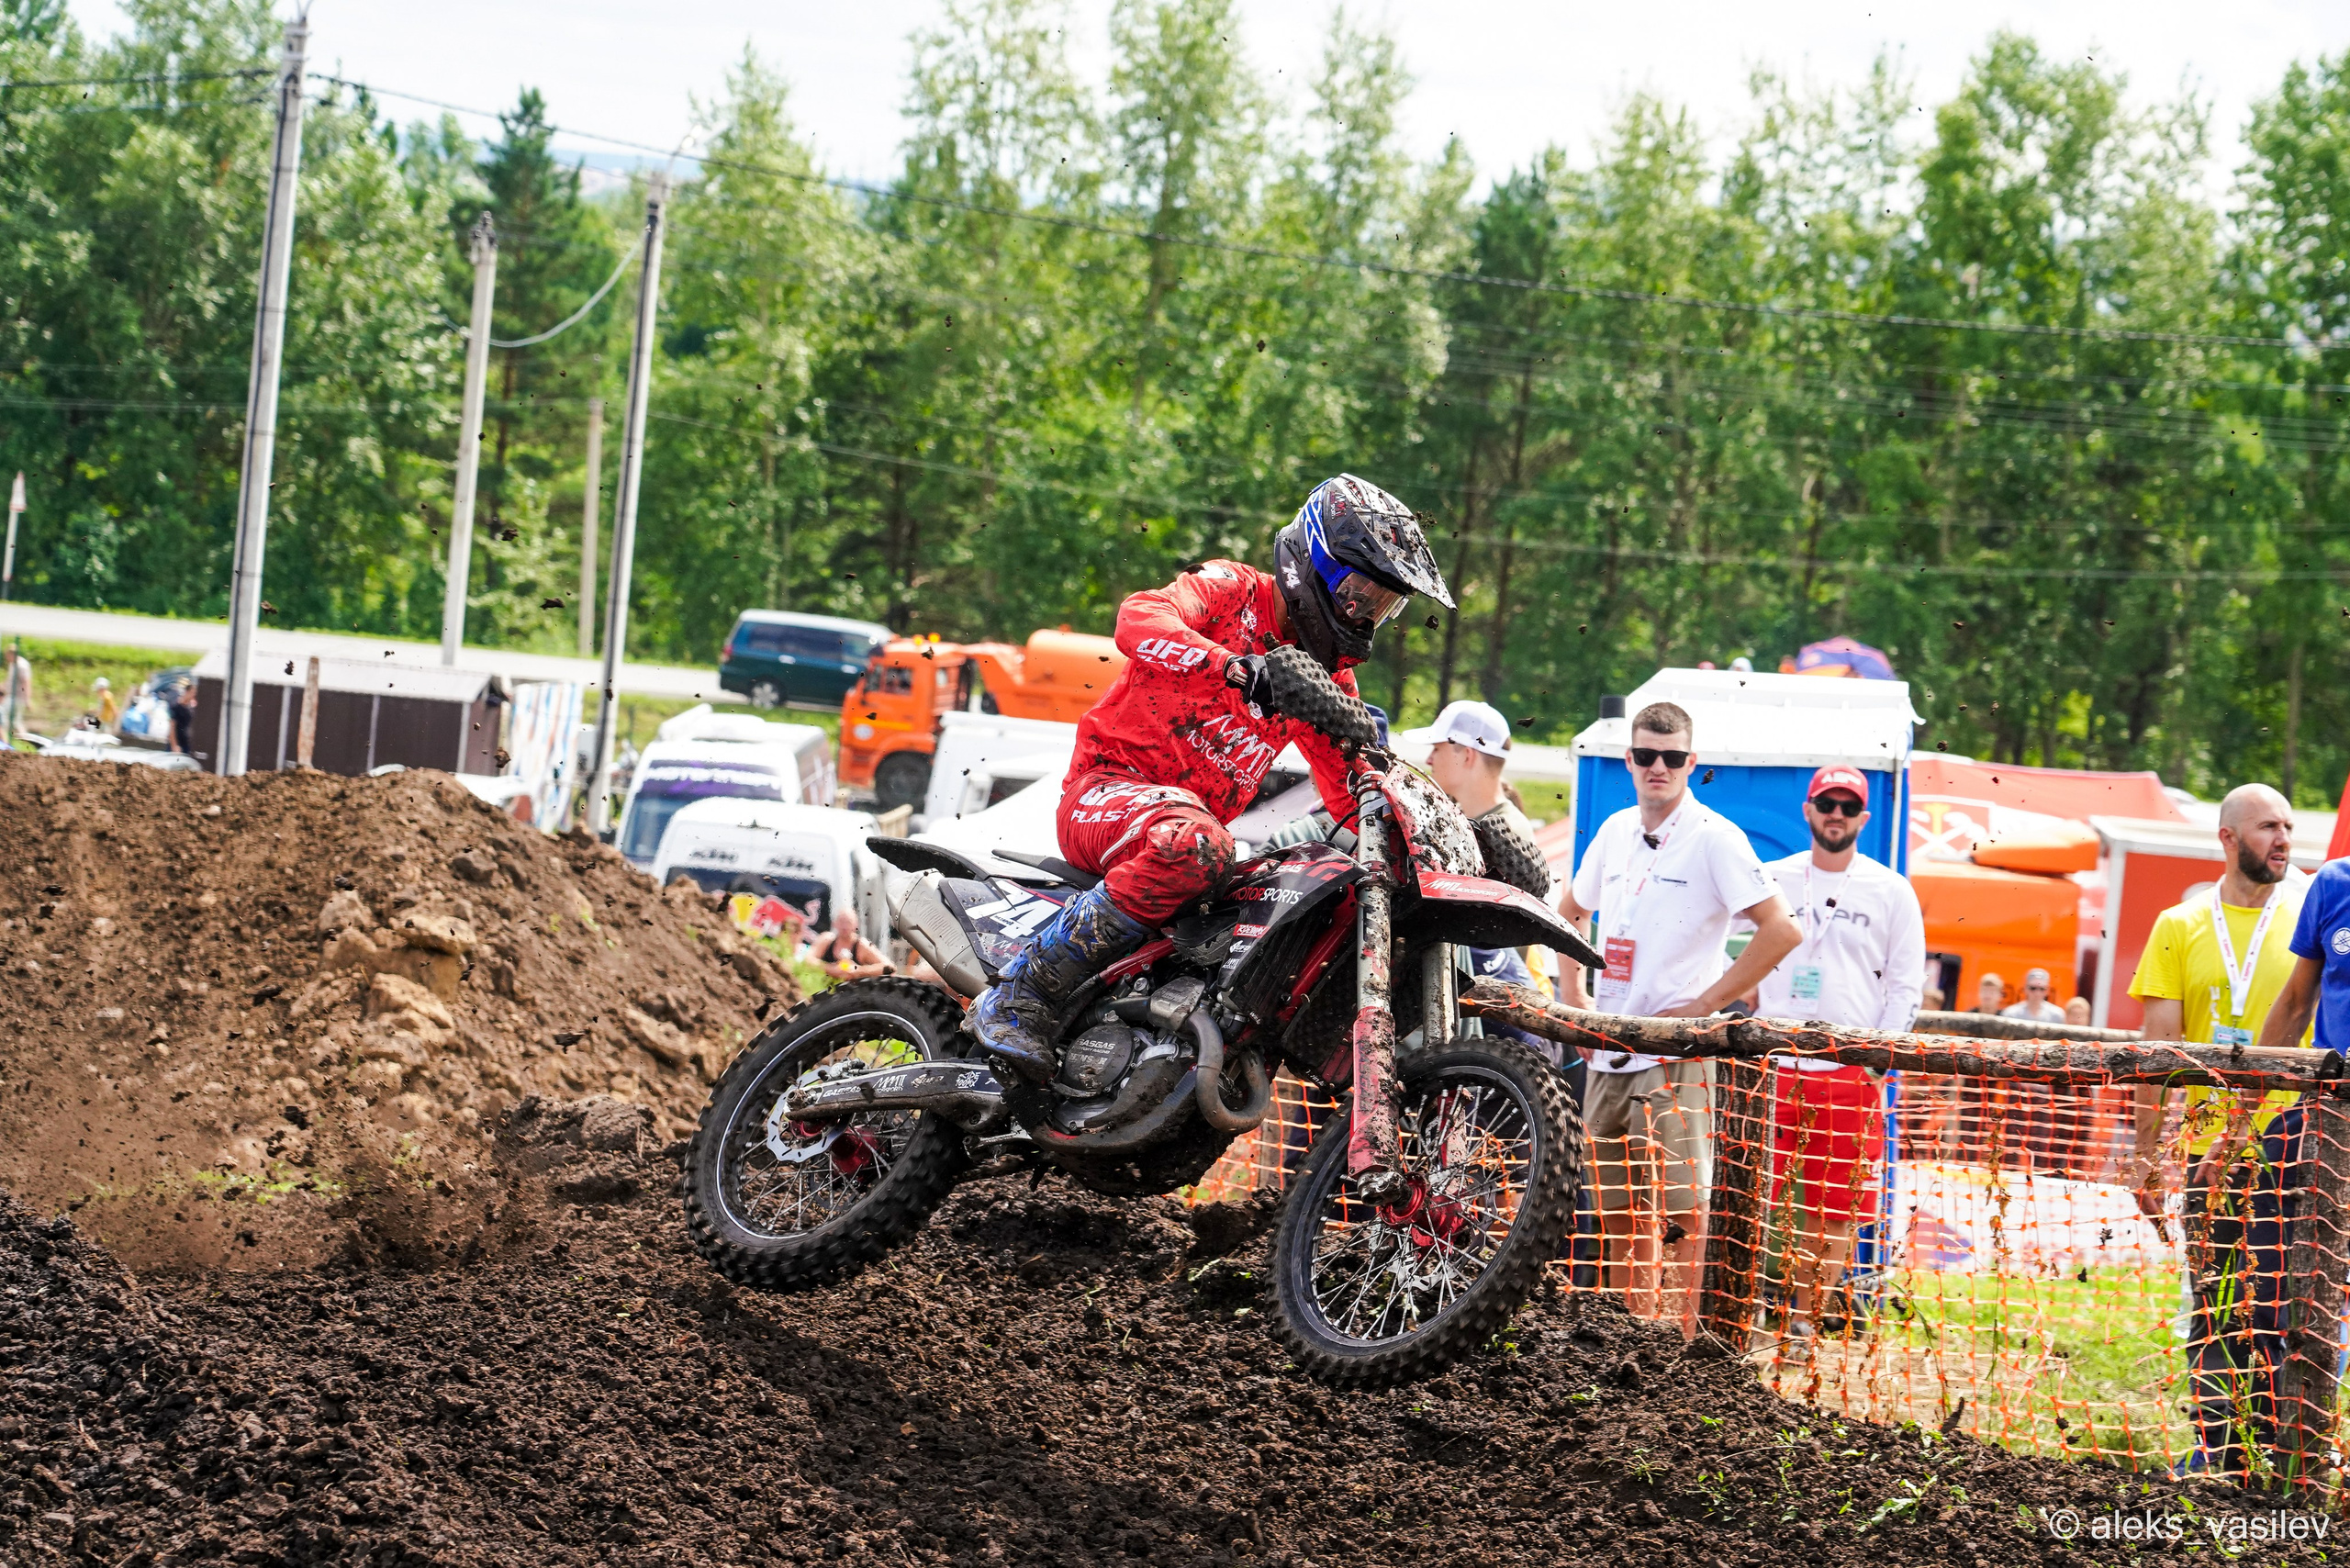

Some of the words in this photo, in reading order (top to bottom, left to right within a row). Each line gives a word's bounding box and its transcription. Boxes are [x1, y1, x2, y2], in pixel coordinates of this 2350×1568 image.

[1136, 637, 1209, 667] UFO
[1070, 802, 1138, 823] PLAST
[965, 879, 1063, 940] 74
